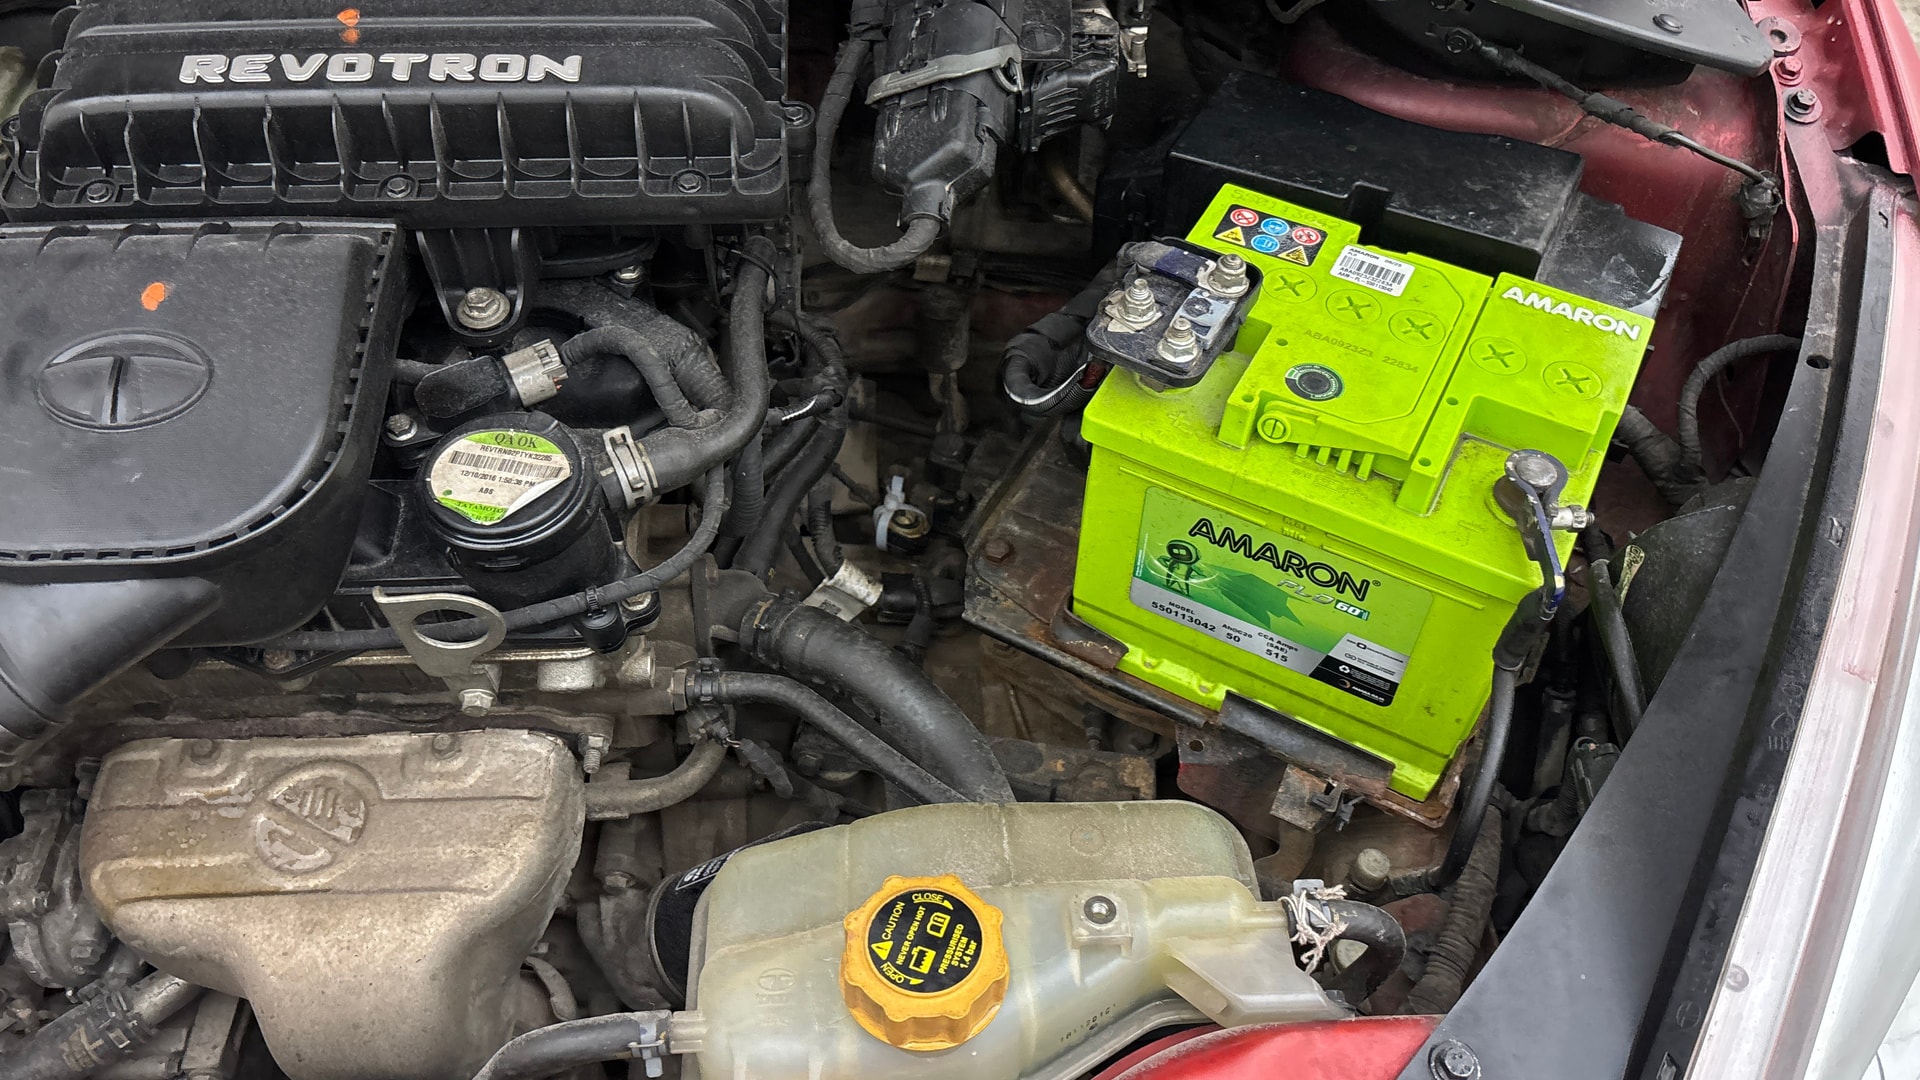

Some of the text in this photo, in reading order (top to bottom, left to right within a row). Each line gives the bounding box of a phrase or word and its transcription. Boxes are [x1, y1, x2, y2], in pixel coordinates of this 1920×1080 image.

[179, 53, 583, 84] REVOTRON
[1501, 286, 1641, 341] AMARON
[1382, 356, 1419, 373] 22834
[494, 433, 538, 449] QA OK
[478, 487, 495, 495] ABS
[1151, 601, 1217, 633] 550113042
[1168, 601, 1195, 615] MODEL
[1225, 632, 1241, 643] 50
[1257, 632, 1299, 652] CCA Amps
[1265, 648, 1288, 663] 515
[1266, 641, 1288, 655] (SAE)
[911, 892, 944, 903] CLOSE
[881, 901, 906, 940] CAUTION
[895, 905, 927, 966] NEVER OPEN HOT
[938, 923, 965, 975] PRESSURISED
[951, 936, 969, 967] SYSTEM
[965, 940, 978, 956] bar
[880, 962, 905, 984] OPEN
